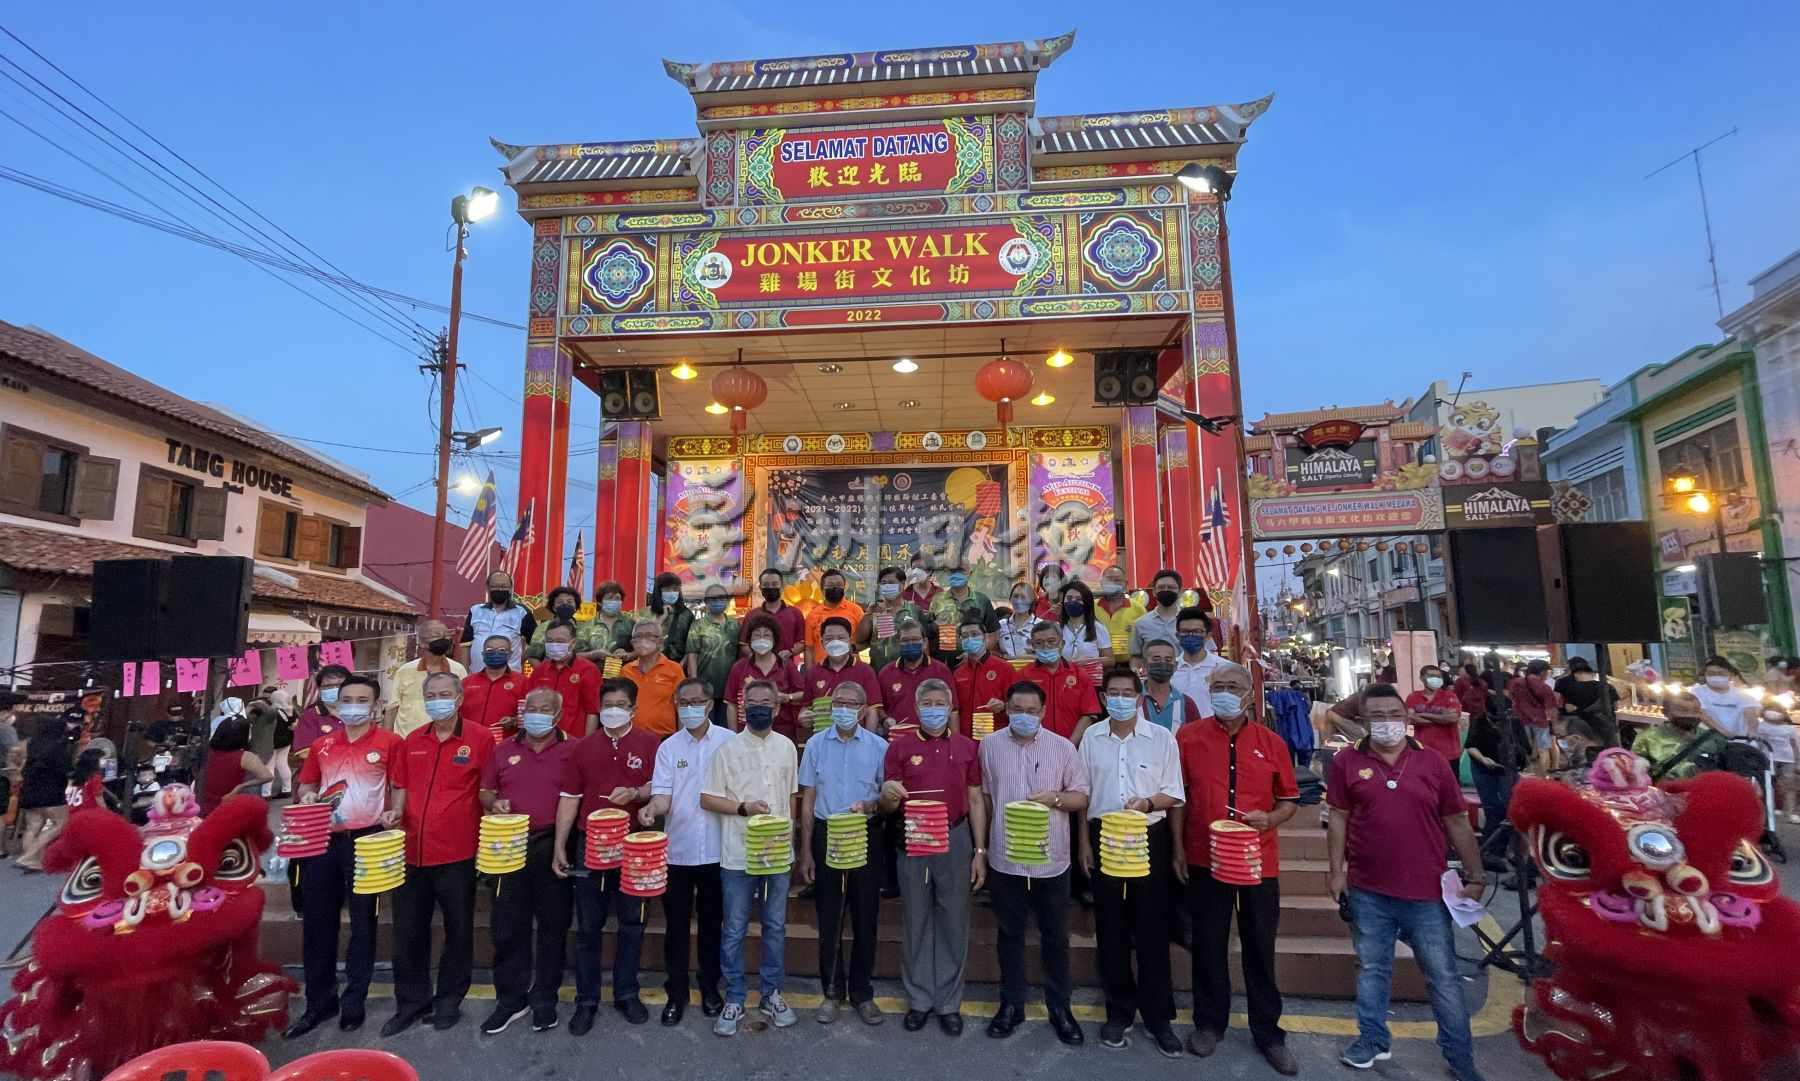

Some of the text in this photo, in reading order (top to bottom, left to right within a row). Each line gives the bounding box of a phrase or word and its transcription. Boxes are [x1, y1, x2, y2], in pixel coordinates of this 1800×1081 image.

[780, 131, 949, 163] SELAMAT DATANG
[808, 161, 922, 188] 歡迎光臨
[740, 231, 990, 267] JONKER WALK
[760, 264, 970, 293] 雞場街文化坊
[846, 309, 882, 321] 2022
[165, 437, 294, 498] TANG HOUSE
[1300, 459, 1361, 474] HIMALAYA
[1261, 498, 1416, 516] SELAMAT DATANG KE JONKER WALK MELAKA
[1464, 498, 1530, 514] HIMALAYA
[1465, 513, 1490, 521] SALT
